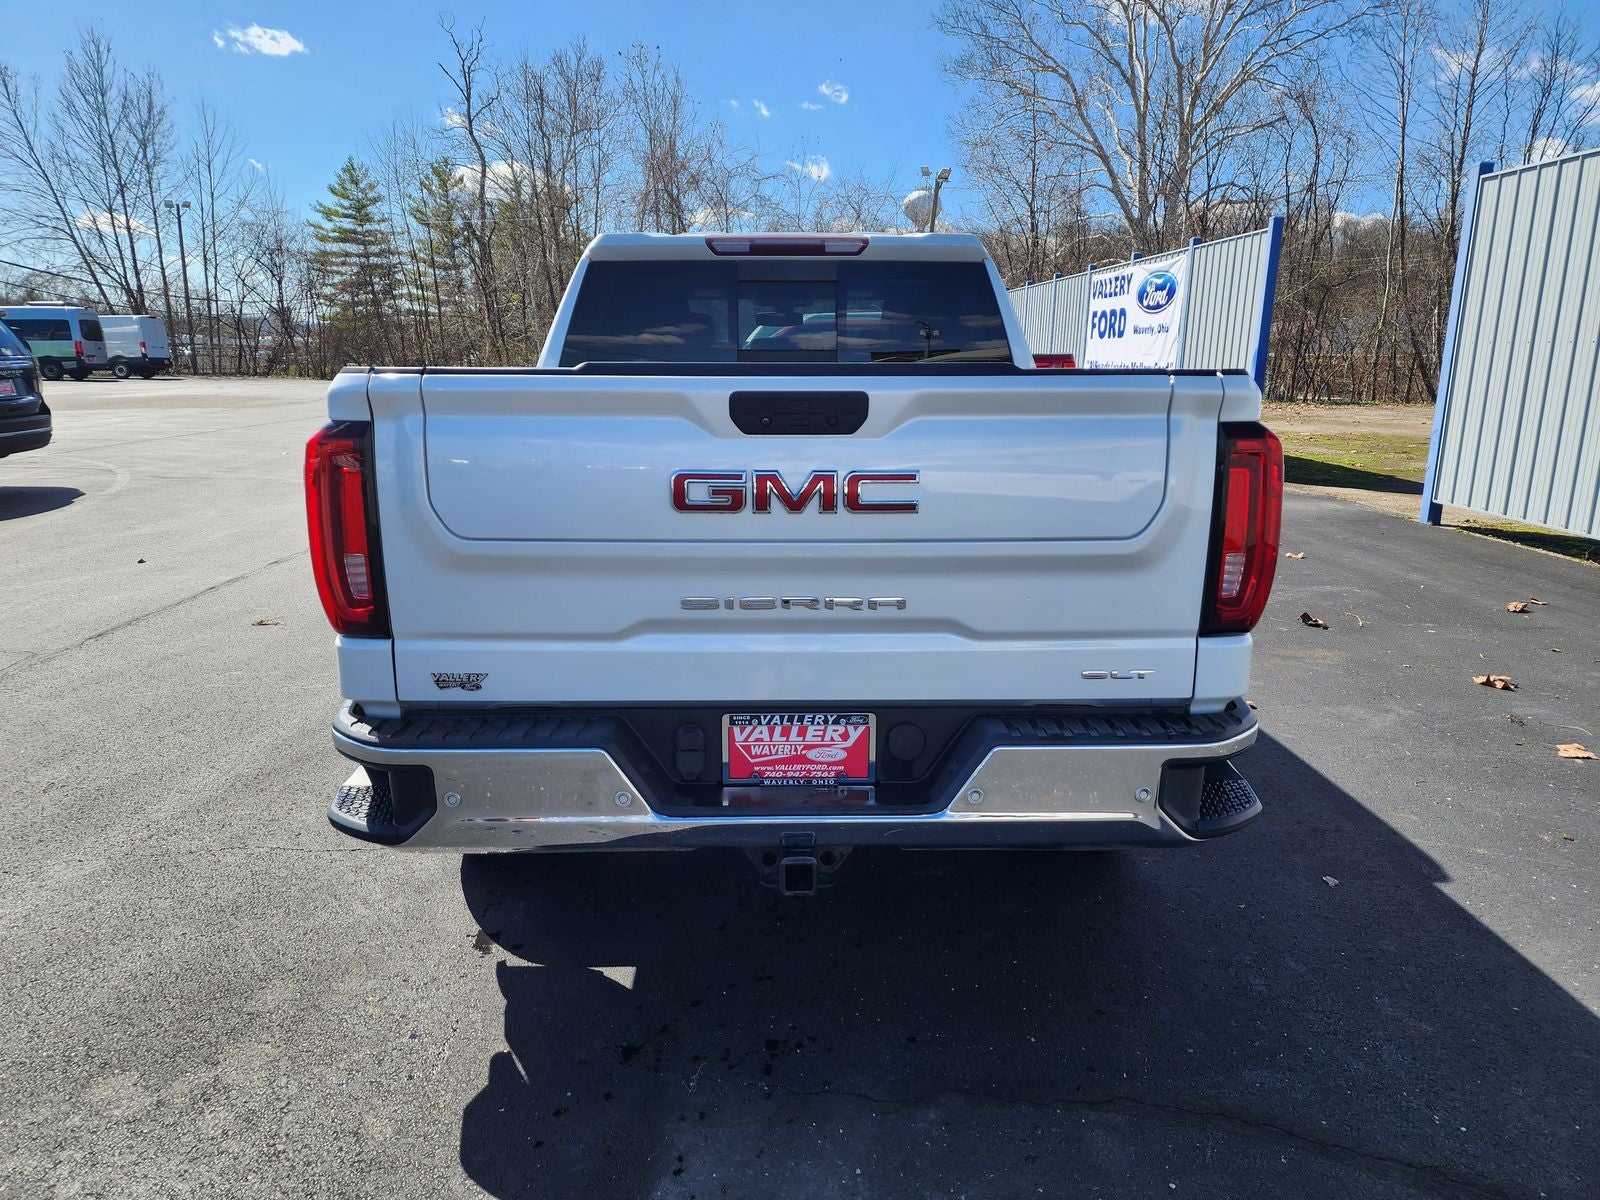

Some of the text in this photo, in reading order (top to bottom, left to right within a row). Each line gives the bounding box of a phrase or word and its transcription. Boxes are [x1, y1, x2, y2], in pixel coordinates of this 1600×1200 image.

[1092, 272, 1133, 300] VALLERY
[1142, 277, 1171, 307] Ford
[1090, 307, 1127, 340] FORD
[1157, 322, 1169, 334] Ohio
[670, 469, 919, 514] GMC
[680, 596, 907, 610] SIERRA
[431, 672, 488, 683] VALLERY
[1081, 669, 1155, 680] SLT
[760, 714, 838, 725] VALLERY
[732, 724, 867, 742] VALLERY
[750, 744, 838, 759] WAVERLY Ford
